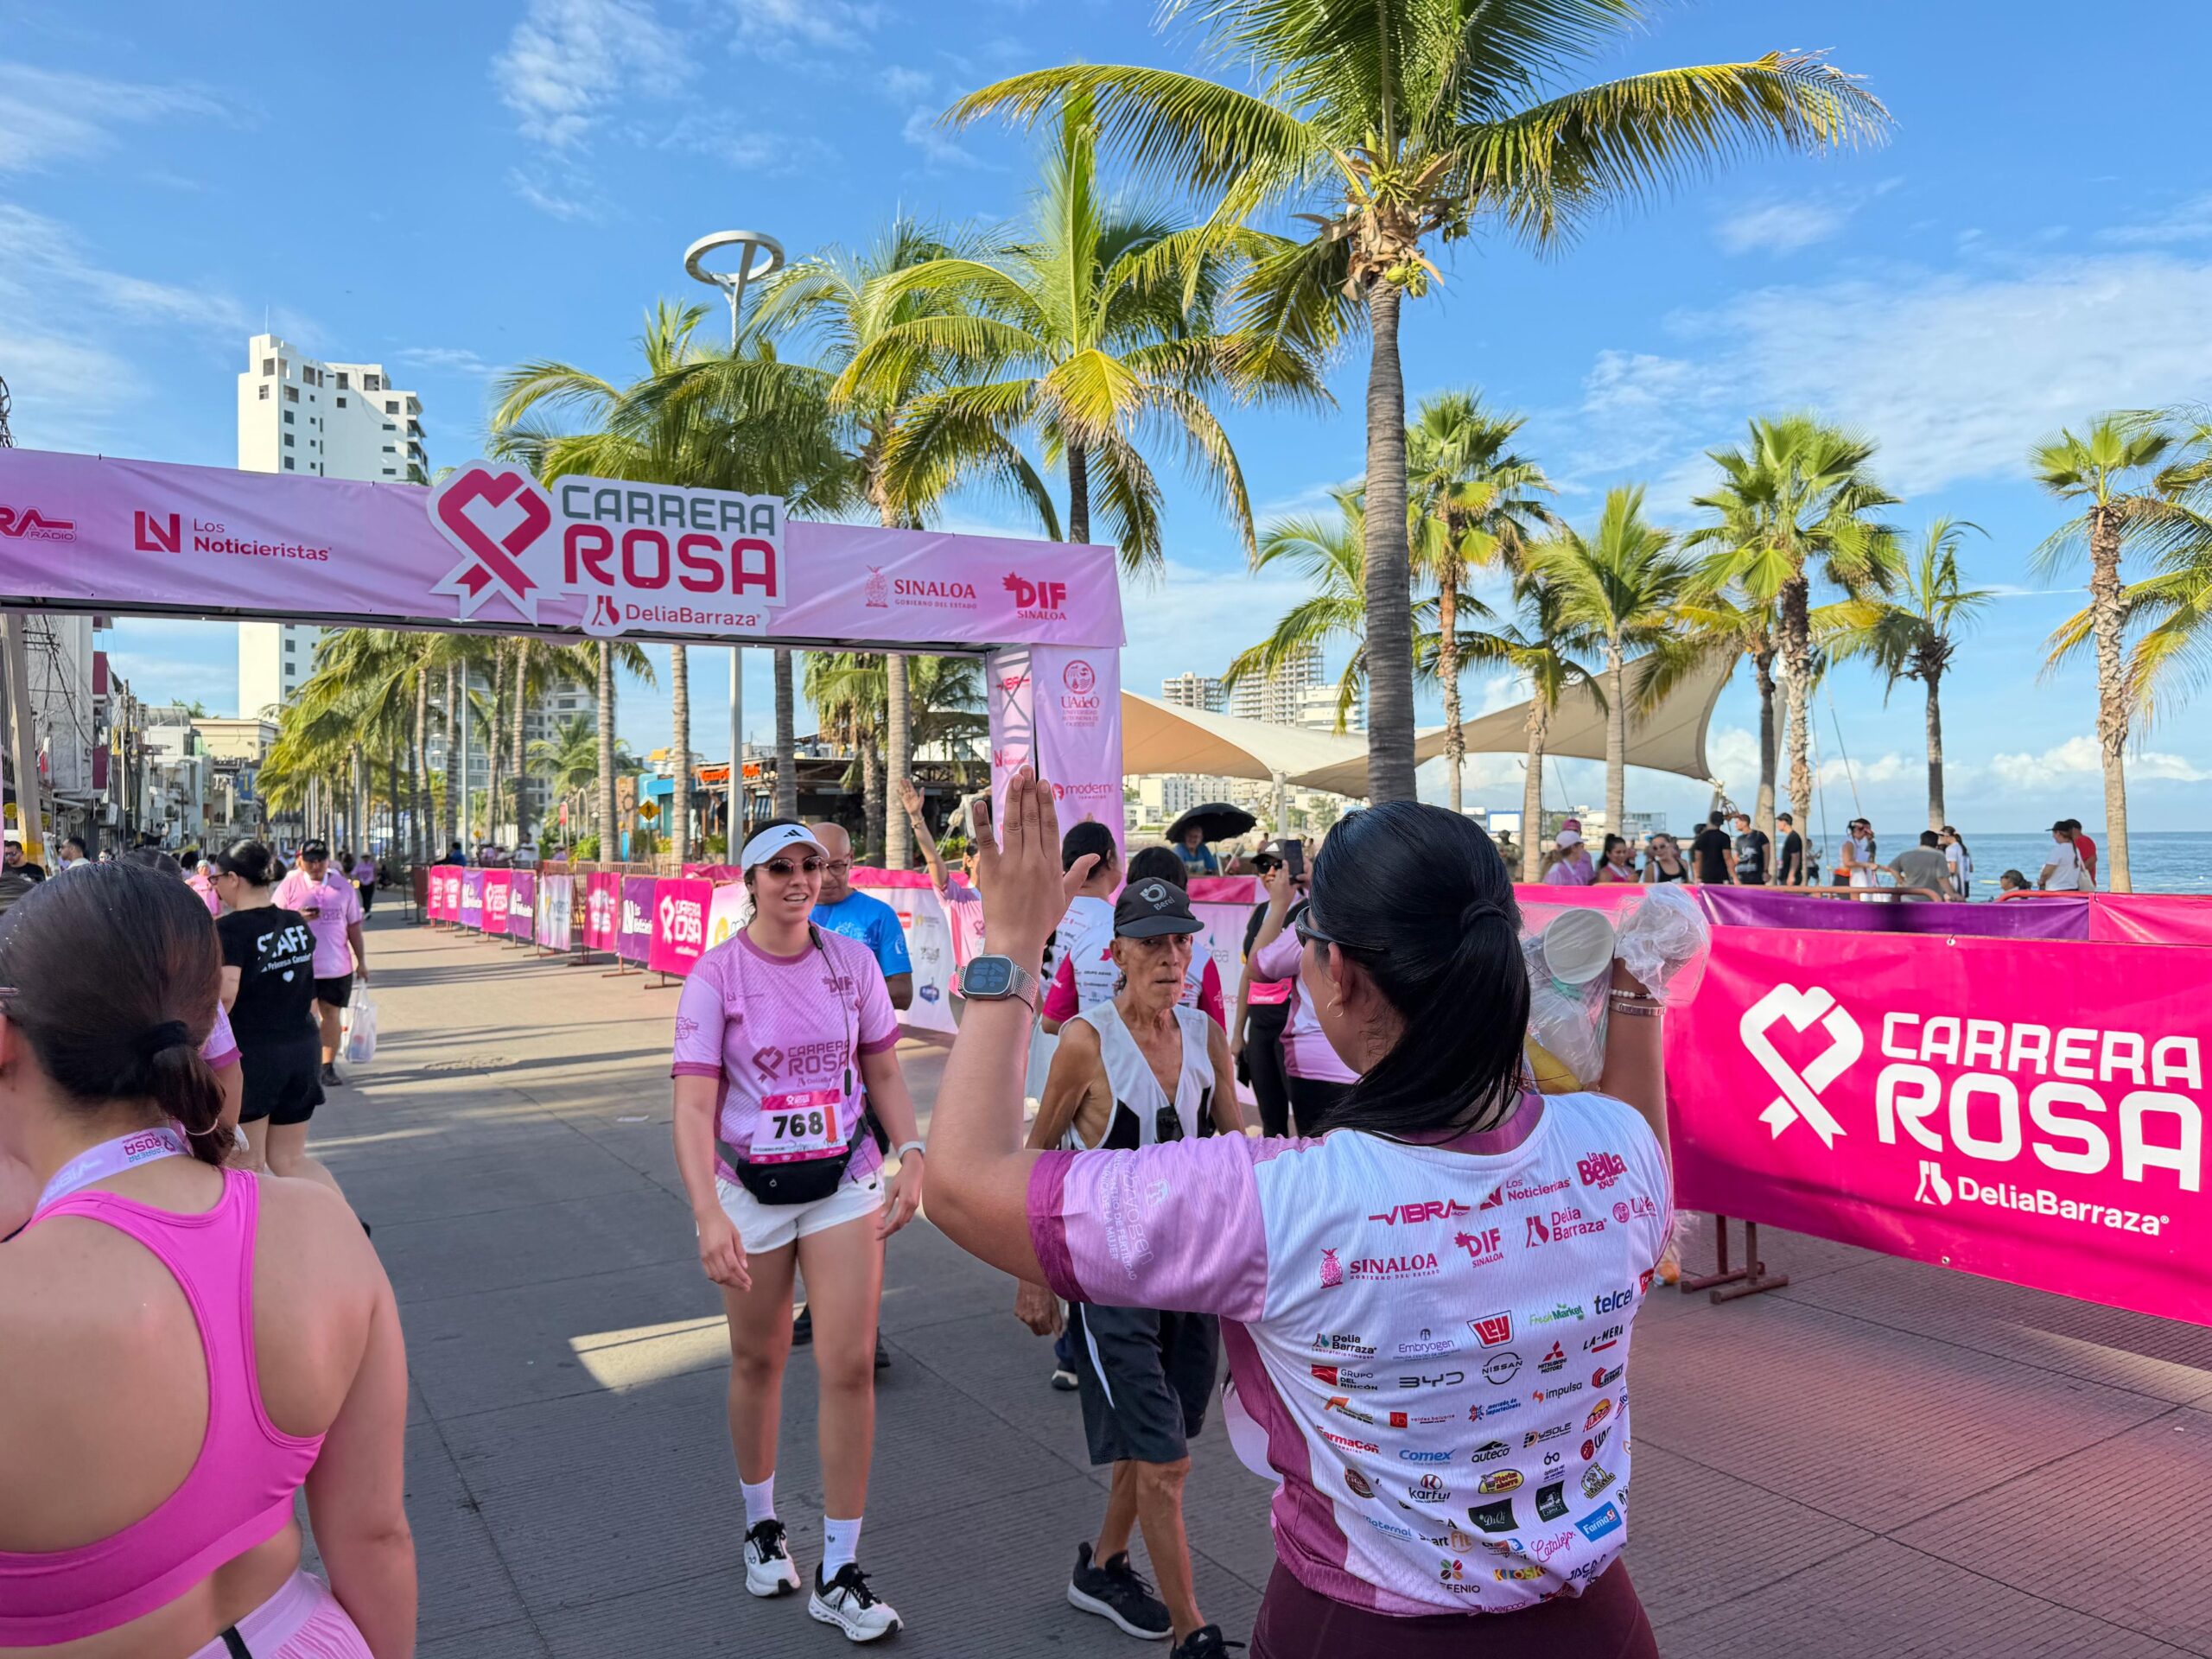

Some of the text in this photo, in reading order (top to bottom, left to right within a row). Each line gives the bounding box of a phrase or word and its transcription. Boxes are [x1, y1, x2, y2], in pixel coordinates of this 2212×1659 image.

[563, 485, 775, 536] CARRERA
[194, 518, 225, 533] Los
[31, 531, 74, 541] RADIO
[194, 536, 329, 562] Noticieristas
[564, 524, 777, 597] ROSA
[894, 580, 976, 599] SINALOA
[1014, 580, 1066, 610] DIF
[894, 599, 933, 607] GOBIERNO
[1017, 610, 1066, 620] SINALOA
[1154, 896, 1175, 911] Berel
[788, 1039, 849, 1058] CARRERA
[1881, 1012, 2203, 1090] CARRERA
[788, 1052, 849, 1077] ROSA
[772, 1112, 824, 1140] 768
[1876, 1063, 2202, 1192] ROSA
[124, 1136, 162, 1156] ROSA
[130, 1147, 165, 1163] CARRERA
[1577, 1152, 1628, 1186] Bella
[1506, 1179, 1522, 1189] Los
[1369, 1198, 1471, 1226] VIBRA
[1551, 1207, 1581, 1226] Delia
[1105, 1226, 1119, 1260] MUJER
[1466, 1228, 1501, 1257] DIF
[1117, 1229, 1137, 1281] FERTILIDAD
[1350, 1253, 1439, 1274] SINALOA
[1472, 1252, 1504, 1268] SINALOA
[1594, 1283, 1634, 1315] telcel
[1332, 1334, 1361, 1344] Delia
[1399, 1339, 1454, 1353] Embryogen
[1583, 1325, 1624, 1351] LA-MERA
[1341, 1369, 1374, 1378] GRUPO
[1482, 1360, 1522, 1375] NISSAN
[1541, 1364, 1562, 1374] MOTORS
[1399, 1371, 1465, 1389] BYD
[1546, 1382, 1582, 1399] impulsa
[1399, 1448, 1457, 1461] Comex
[1471, 1446, 1511, 1463] auteco
[1408, 1487, 1451, 1500] karful
